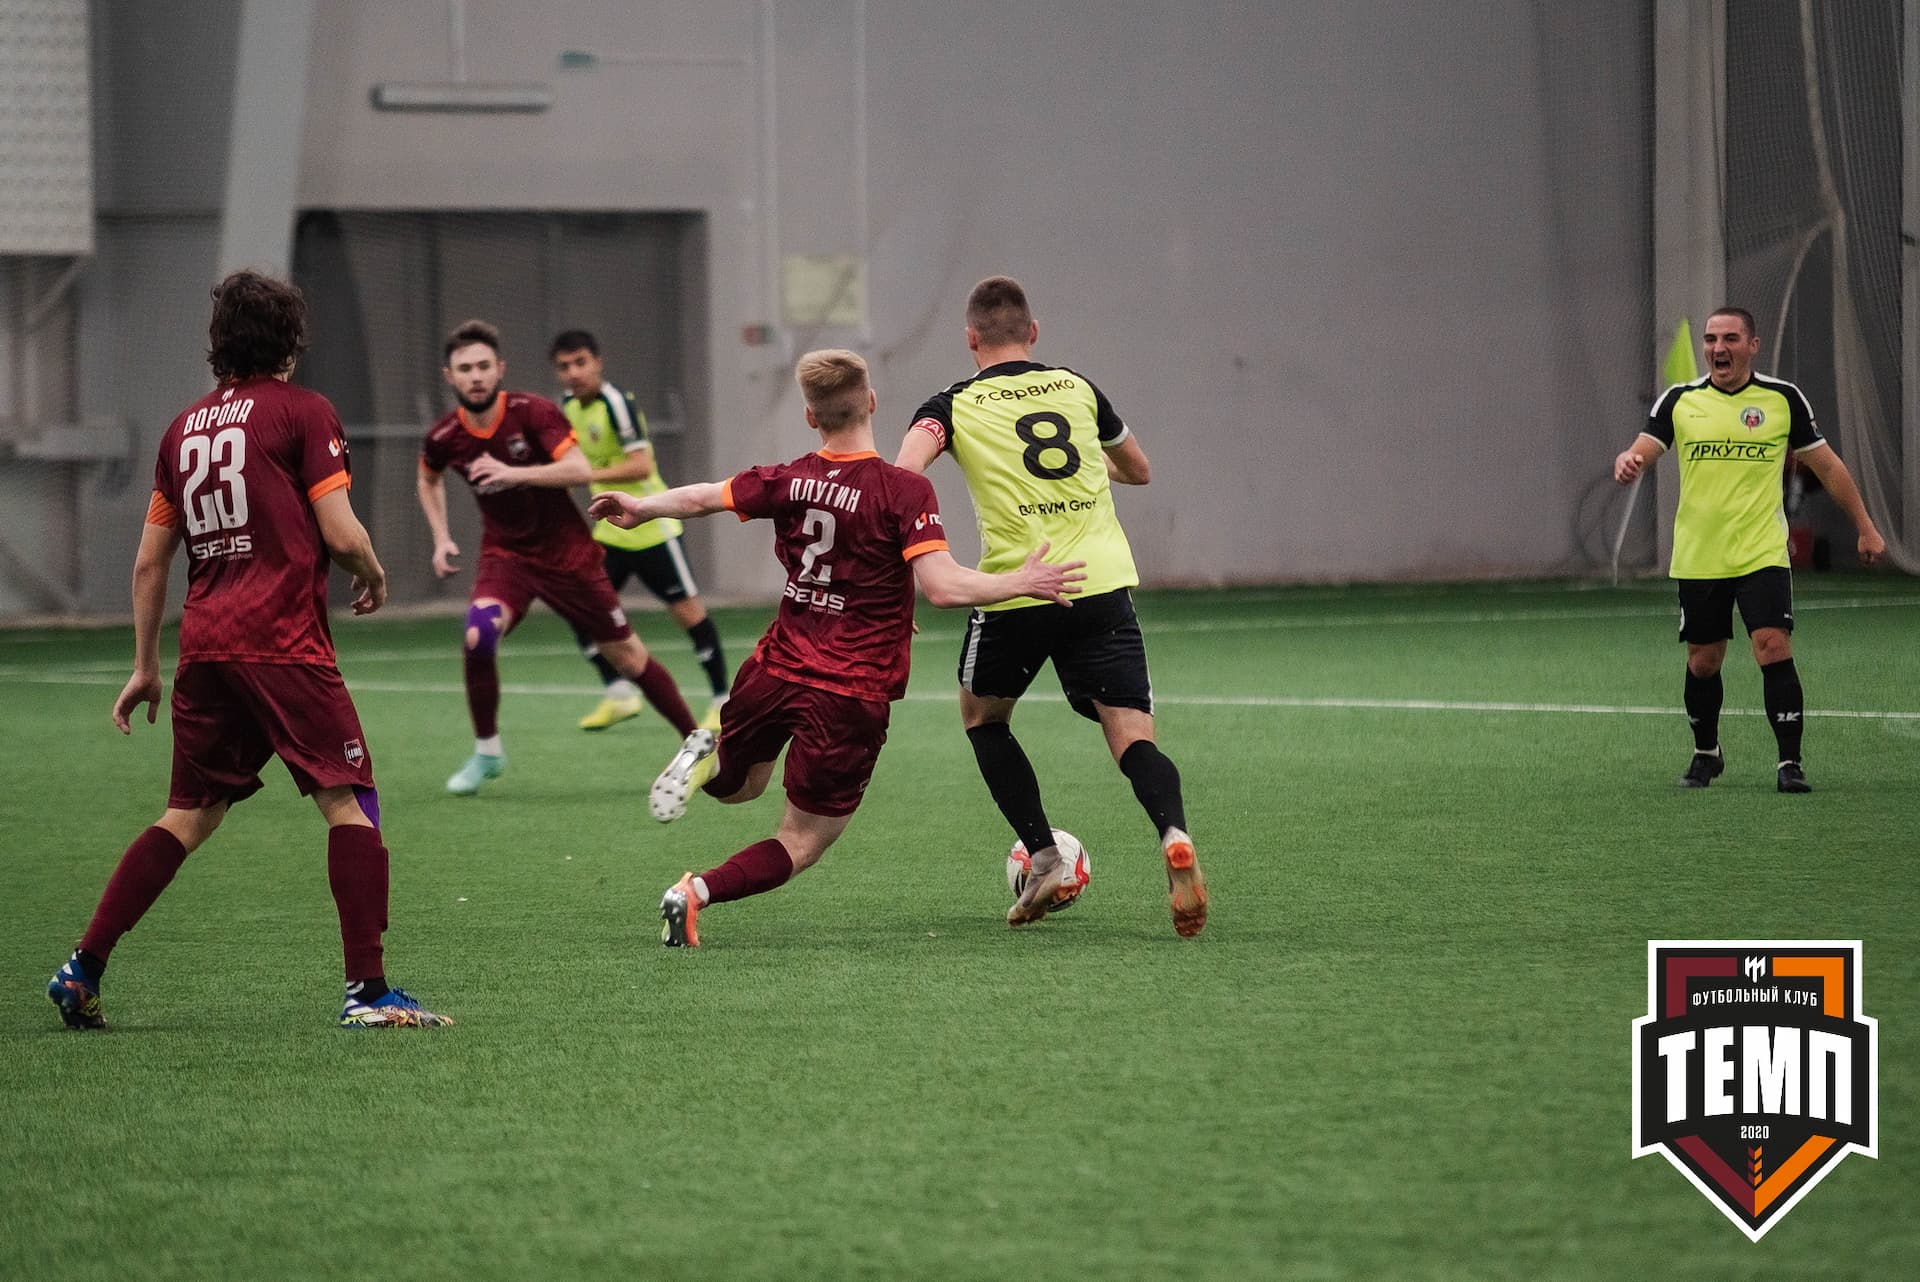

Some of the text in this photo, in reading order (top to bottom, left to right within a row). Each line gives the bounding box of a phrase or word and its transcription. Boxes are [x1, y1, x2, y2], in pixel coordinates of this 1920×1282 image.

[183, 398, 254, 436] ВОРОНА
[1015, 411, 1081, 480] 8
[1690, 444, 1768, 460] ИРКУТСК
[179, 427, 248, 537] 23
[789, 477, 862, 513] ПЛУГИН
[1038, 501, 1066, 515] RVM
[191, 534, 253, 560] SEUS
[797, 508, 836, 586] 2
[783, 581, 846, 610] SEUS
